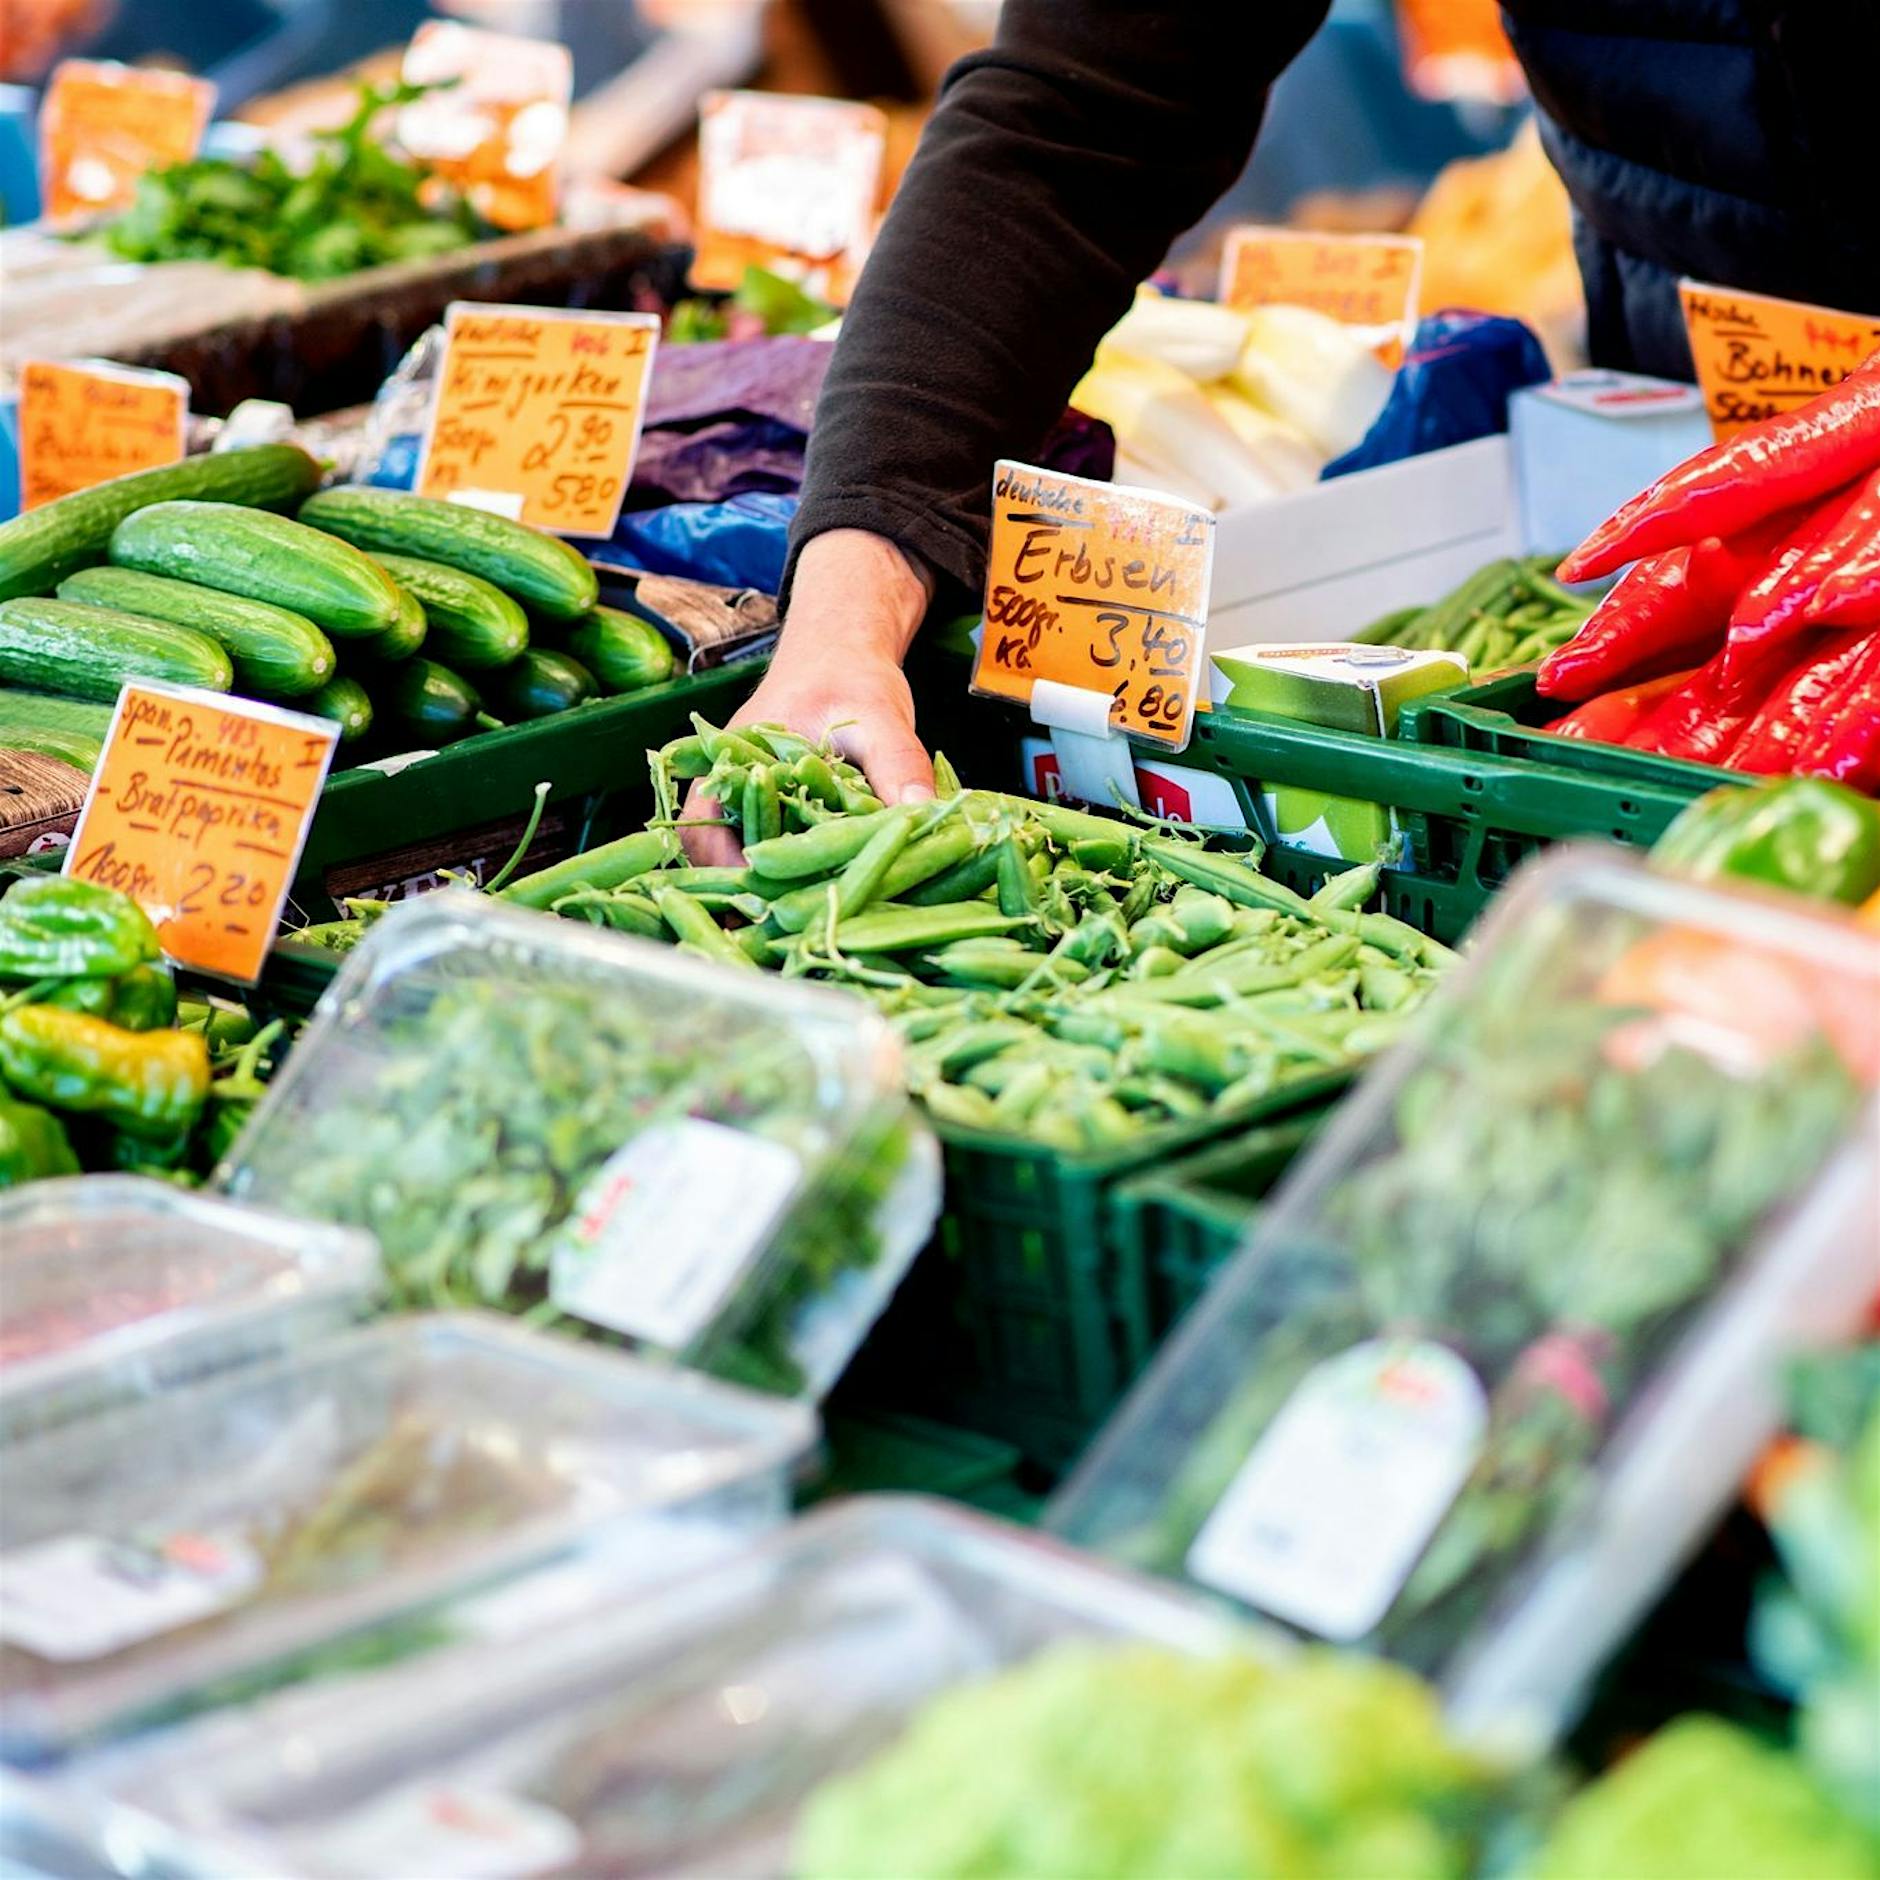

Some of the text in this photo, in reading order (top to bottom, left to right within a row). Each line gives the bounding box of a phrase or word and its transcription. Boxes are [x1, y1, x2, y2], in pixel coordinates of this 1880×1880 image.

[995, 470, 1083, 515] deutsche
[1014, 529, 1178, 597] Erbsen
[164, 715, 282, 788] Pimentos
